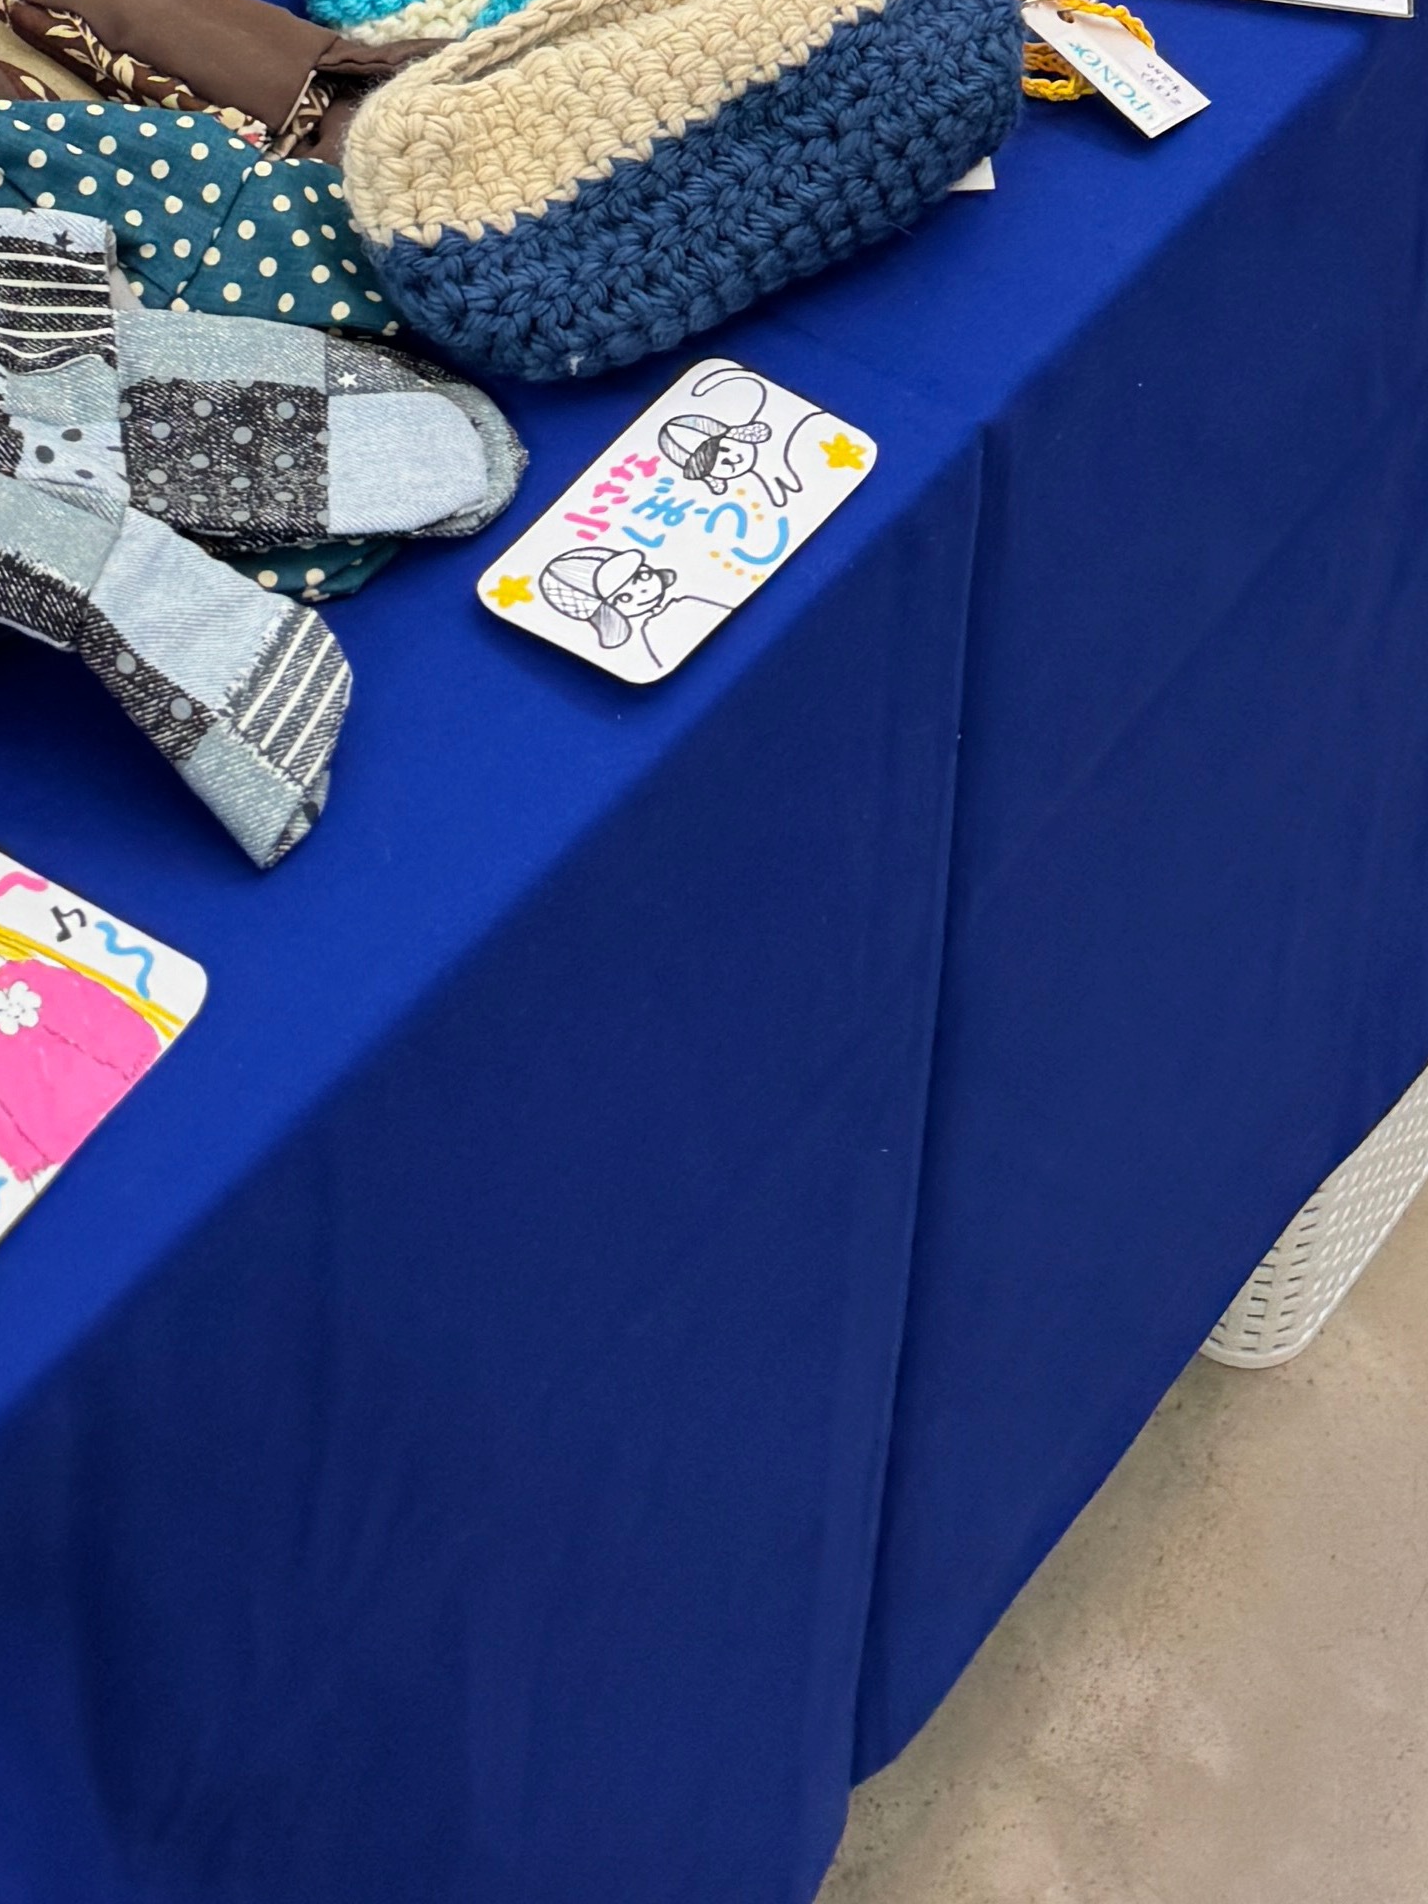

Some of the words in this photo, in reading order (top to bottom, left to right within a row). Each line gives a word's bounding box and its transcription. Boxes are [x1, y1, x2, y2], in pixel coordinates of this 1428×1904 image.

[1067, 38, 1156, 122] PONO
[563, 452, 662, 542] 小さな
